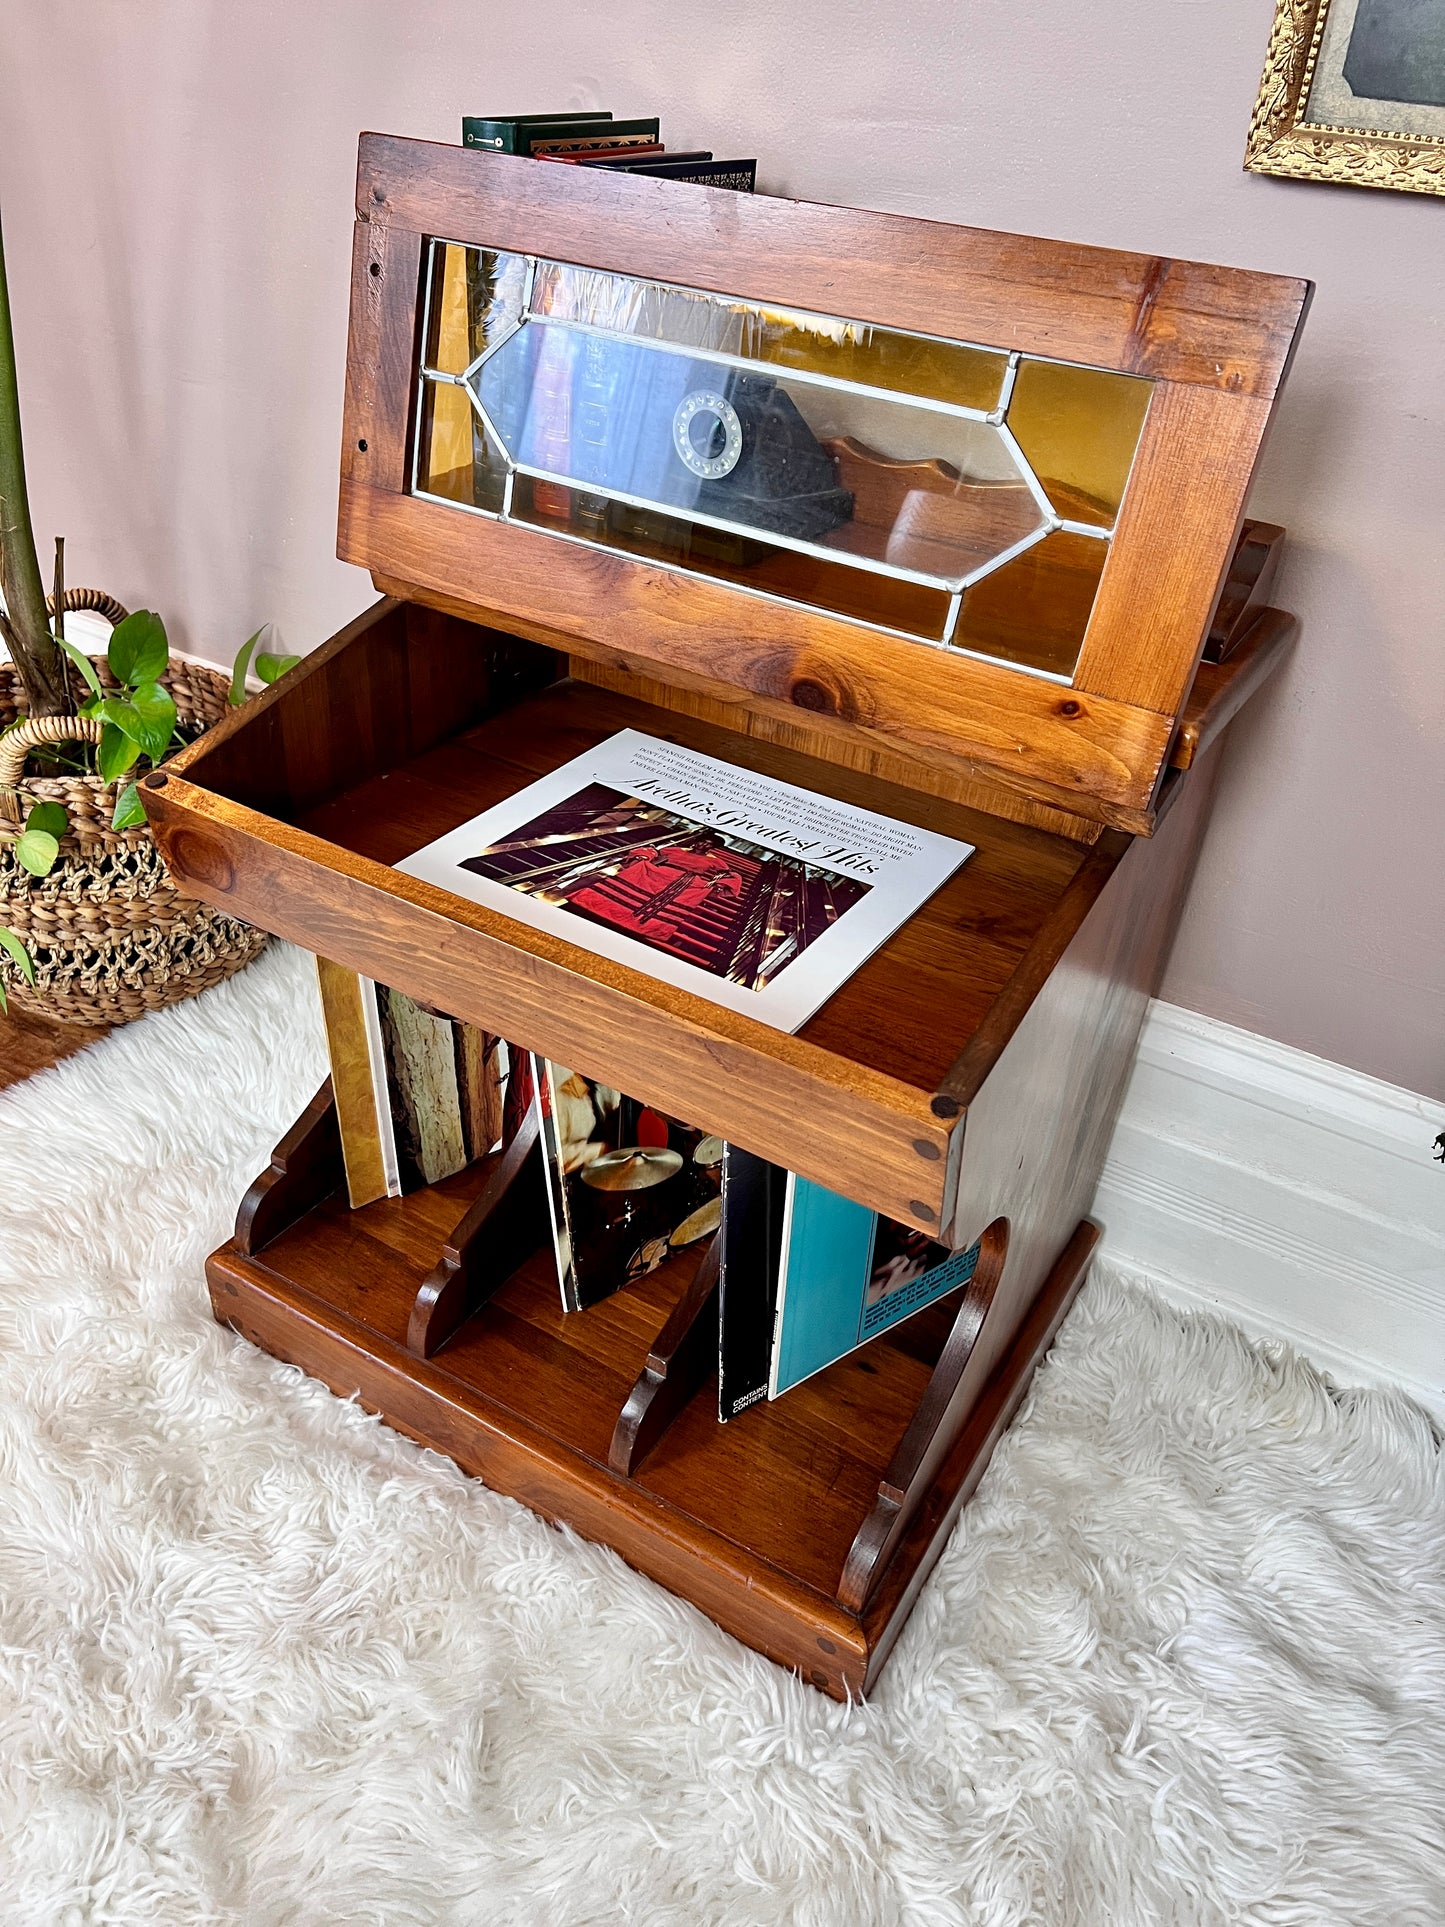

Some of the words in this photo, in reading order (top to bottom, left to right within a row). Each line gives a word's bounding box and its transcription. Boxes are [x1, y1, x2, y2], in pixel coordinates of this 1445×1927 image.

[593, 772, 717, 815] Aretha's
[704, 810, 822, 851] Greatest
[797, 844, 886, 875] Hits
[634, 753, 661, 766] RESPECT
[667, 766, 688, 776] CHAIN
[698, 778, 718, 788] FOOLS
[747, 795, 769, 806] LITTLE
[771, 804, 797, 816] PRAYER
[804, 816, 828, 827] BRIDGE
[831, 825, 849, 835] OVER
[852, 832, 888, 848] TROUBLED
[889, 845, 913, 856] WATER
[634, 761, 656, 772] NEVER
[656, 770, 678, 780] LOVED
[684, 780, 698, 788] MAN
[806, 824, 825, 834] NEED
[838, 835, 850, 843] GET
[870, 847, 889, 856] CALL
[657, 754, 675, 764] PLAY
[675, 761, 692, 770] THAT
[692, 768, 710, 777] SONG
[818, 813, 839, 823] RIGHT
[840, 821, 866, 833] WOMAN
[883, 835, 904, 845] RIGHT
[906, 842, 923, 851] MAN
[658, 747, 684, 759] SPANISH
[685, 757, 712, 770] HARLEM
[740, 777, 757, 786] LOVE
[758, 784, 772, 792] YOU
[855, 817, 887, 831] NATURAL
[889, 828, 916, 840] WOMAN
[733, 1383, 768, 1407] CONTAINS
